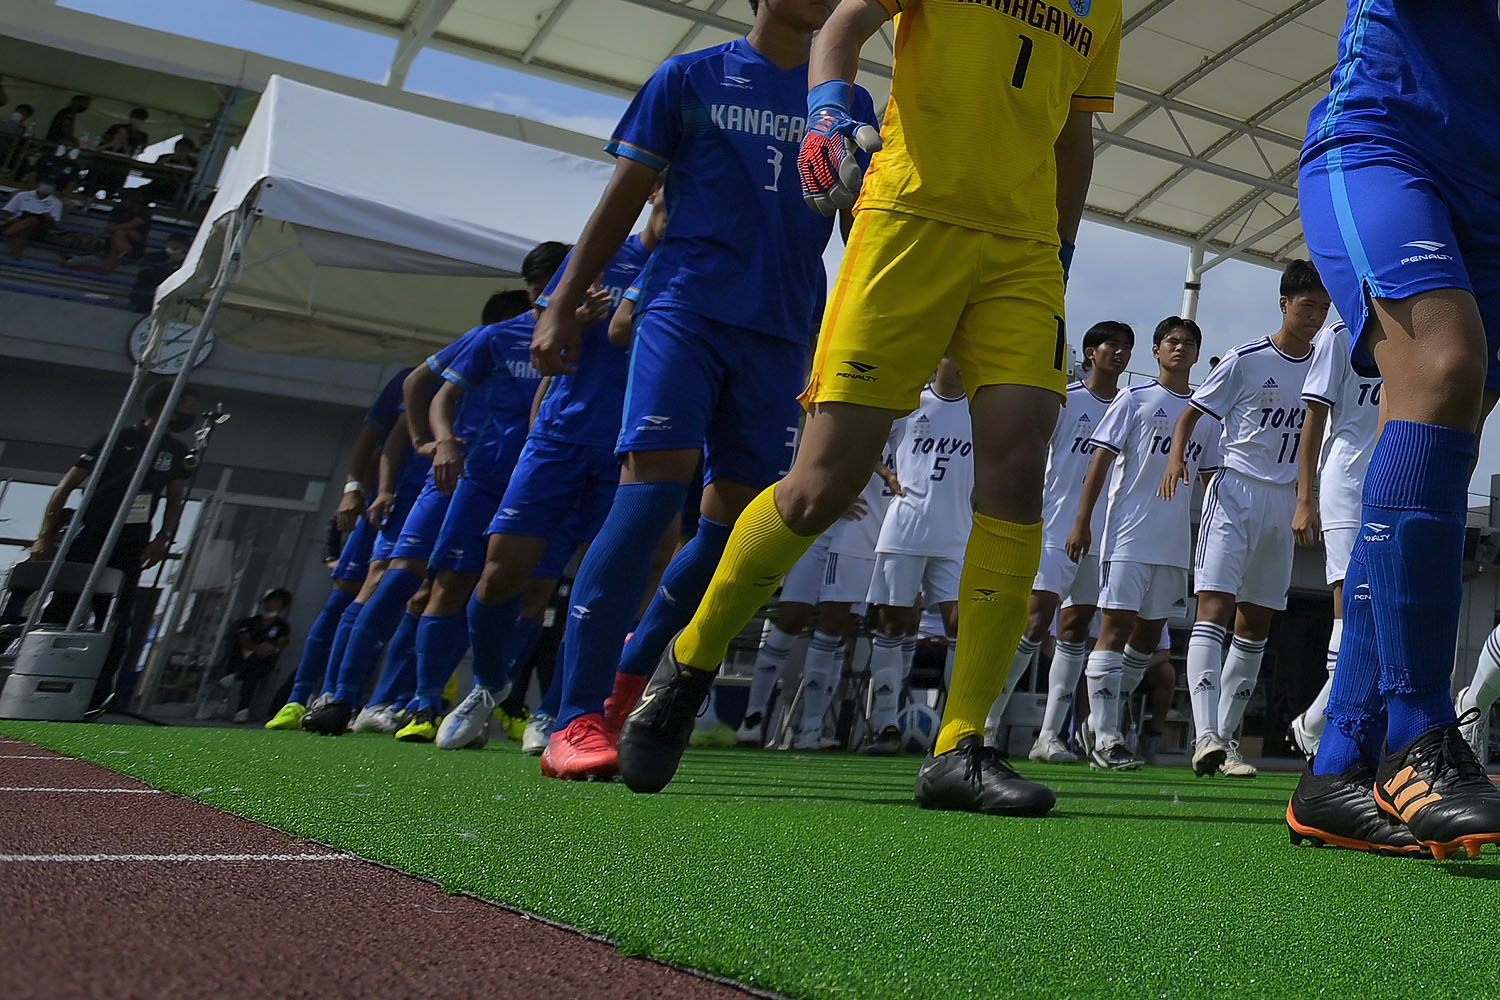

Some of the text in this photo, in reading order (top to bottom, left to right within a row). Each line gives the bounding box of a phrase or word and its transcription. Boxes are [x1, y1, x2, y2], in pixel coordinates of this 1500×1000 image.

[1011, 34, 1034, 90] 1
[711, 104, 807, 144] KANAGA
[764, 145, 784, 192] 3
[1401, 253, 1453, 265] PENALTY
[1053, 315, 1065, 371] 1
[836, 372, 878, 383] PENALTY
[912, 437, 973, 458] TOKYO
[1277, 432, 1301, 464] 11
[930, 457, 950, 481] 5
